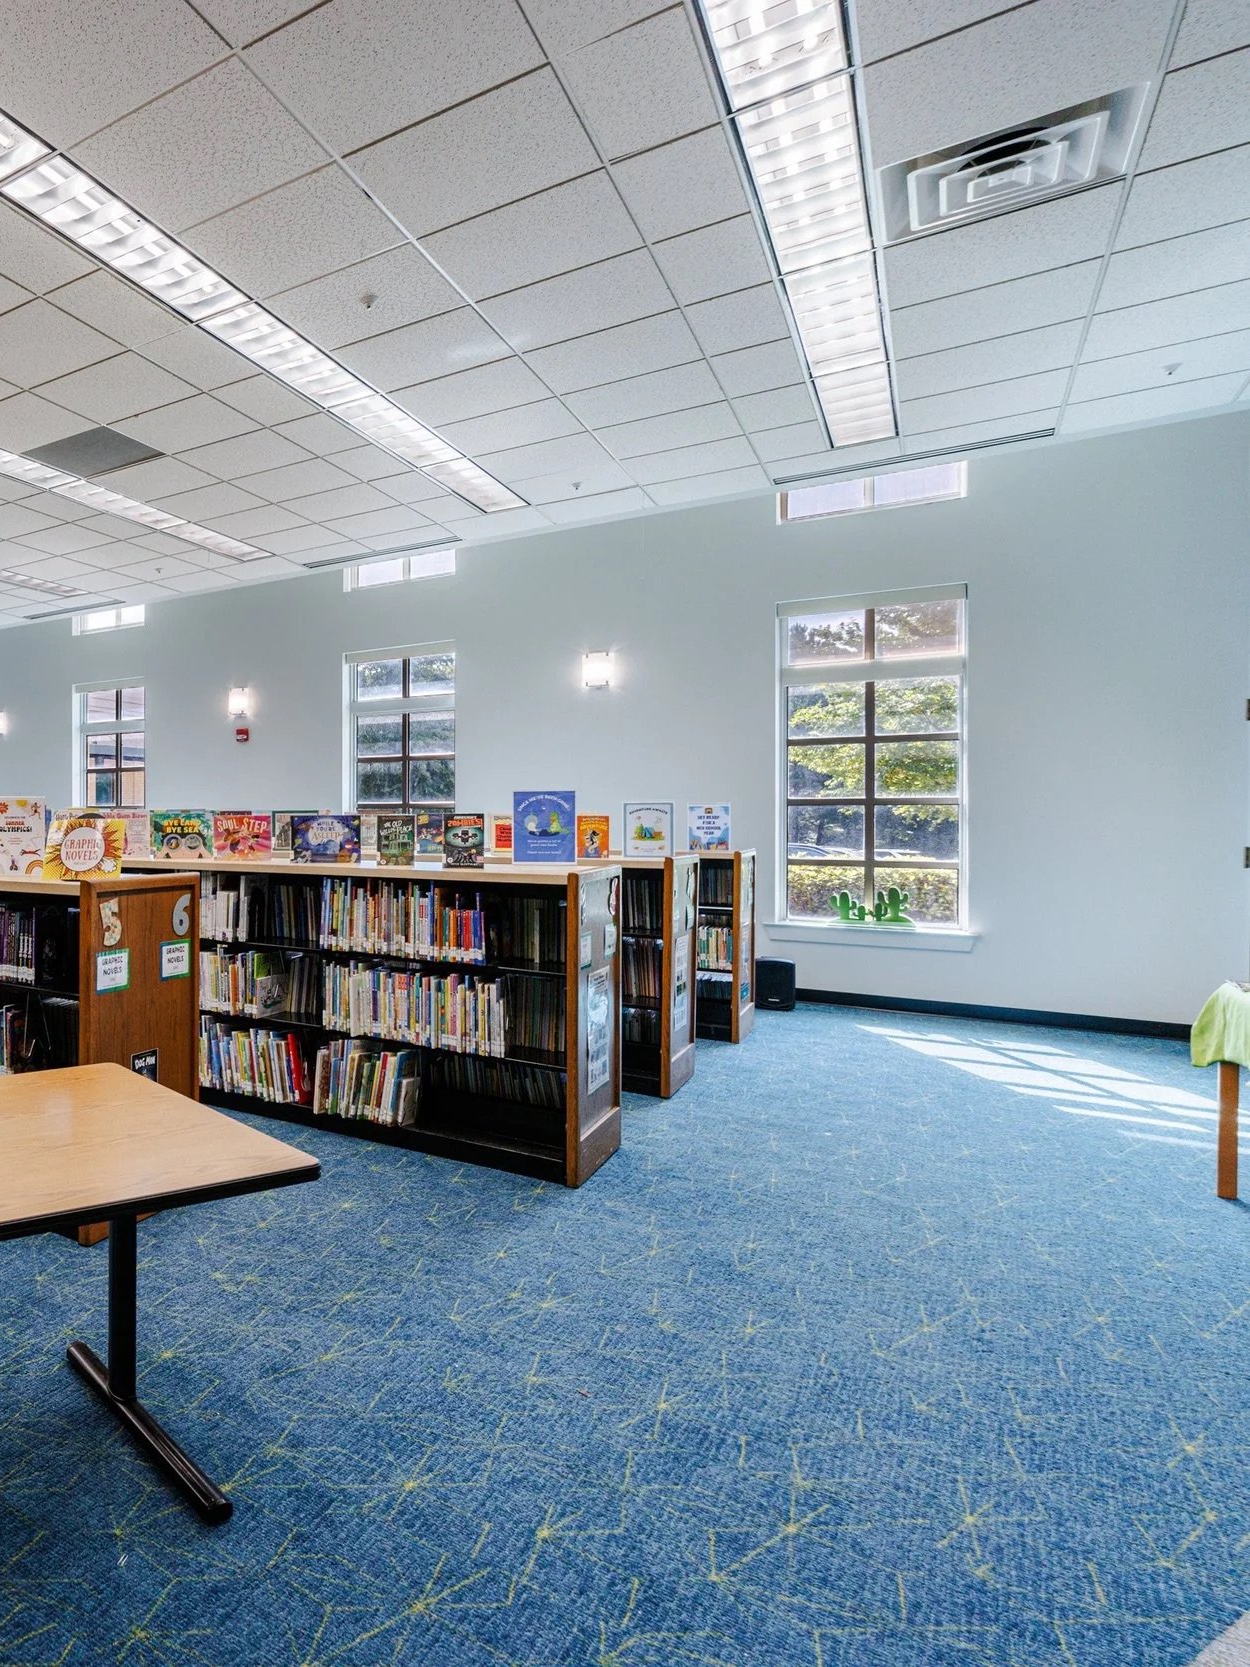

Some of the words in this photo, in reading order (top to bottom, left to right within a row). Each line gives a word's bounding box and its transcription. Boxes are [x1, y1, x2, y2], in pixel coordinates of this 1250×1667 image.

[216, 818, 239, 833] SOUL
[242, 817, 268, 834] STEP
[392, 820, 403, 828] OLD
[312, 831, 341, 840] ASLEEP
[64, 839, 102, 850] GRAPHIC
[65, 850, 99, 861] NOVELS
[172, 893, 192, 937] 6
[99, 897, 123, 947] 5
[165, 945, 185, 955] GRAPHIC
[101, 955, 123, 966] GRAPHIC
[167, 955, 184, 965] NOVELS
[102, 966, 123, 976] NOVELS
[134, 1057, 146, 1071] DOG
